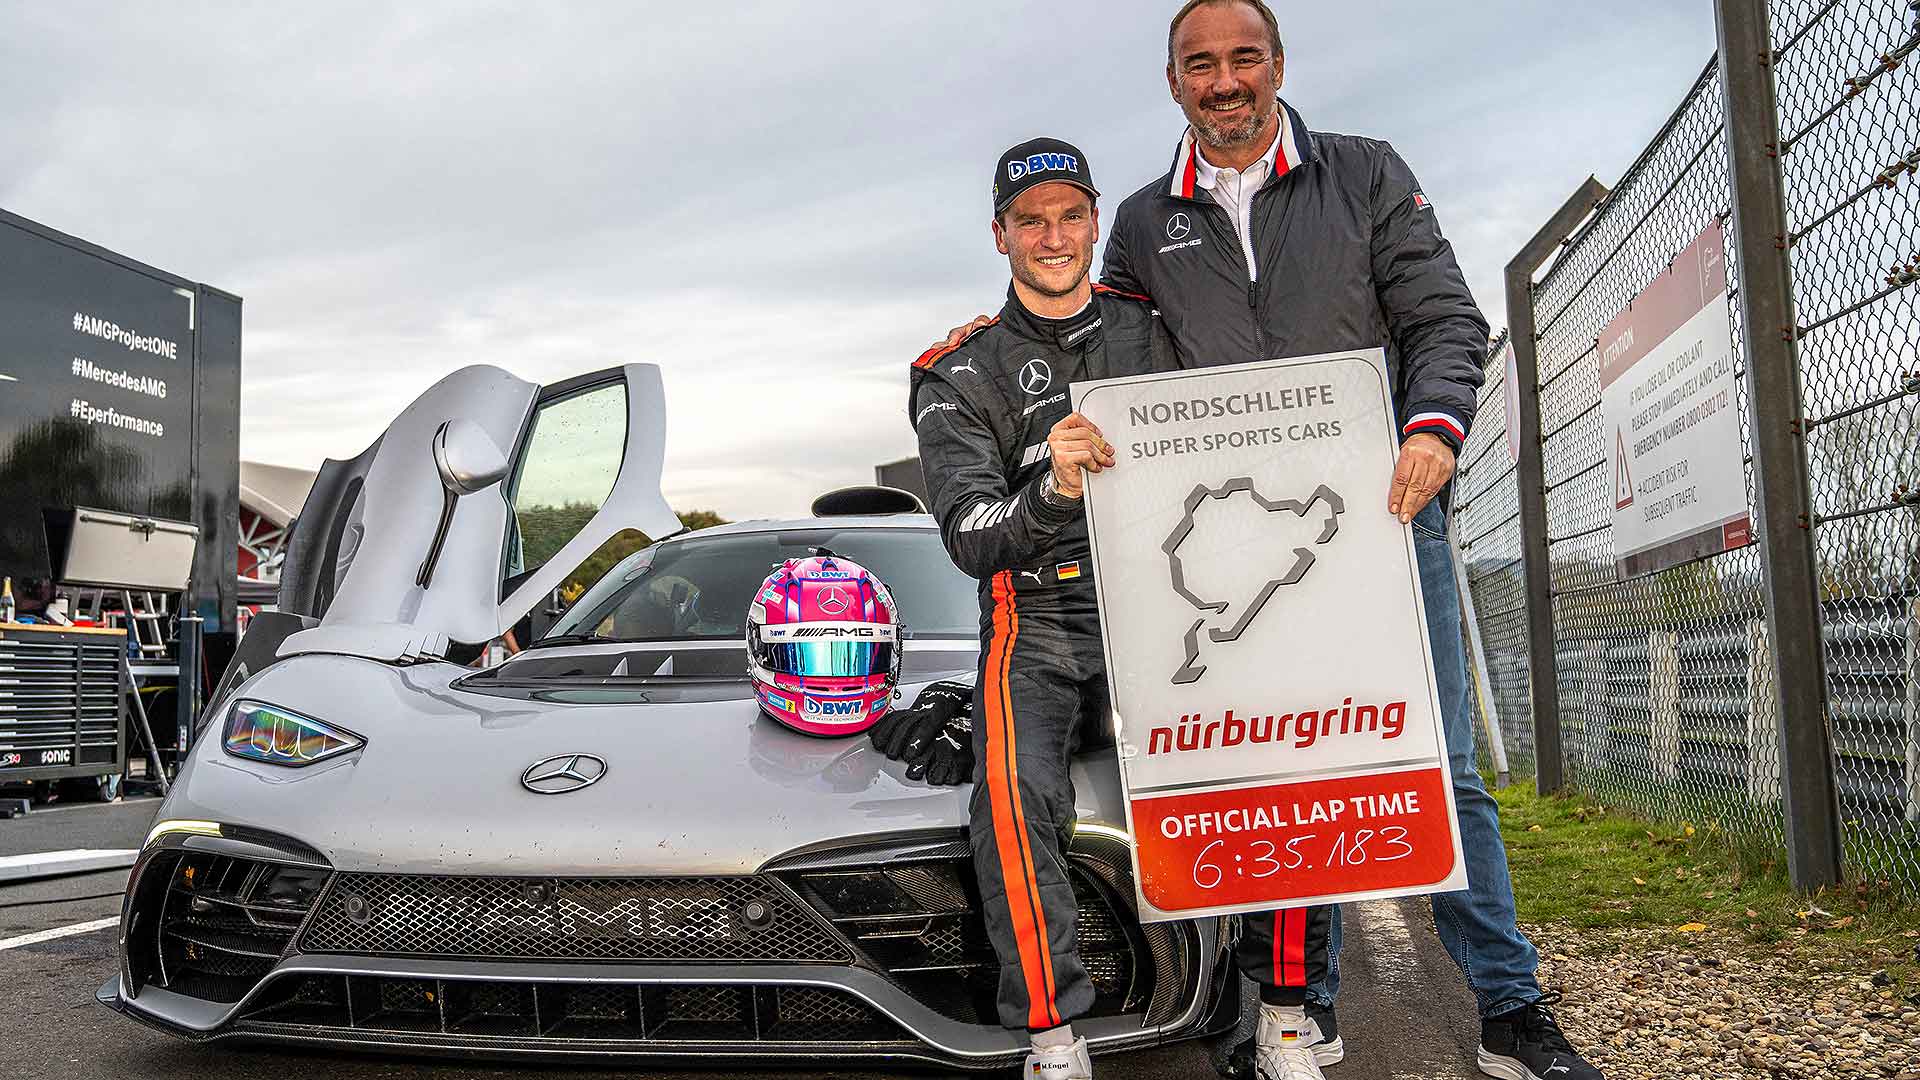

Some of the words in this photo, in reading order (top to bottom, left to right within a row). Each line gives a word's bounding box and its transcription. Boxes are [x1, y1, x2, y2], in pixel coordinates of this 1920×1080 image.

[1027, 153, 1078, 174] BWT
[73, 311, 177, 360] #AMGProjectONE
[1603, 326, 1634, 369] ATTENTION
[72, 357, 167, 398] #MercedesAMG
[1646, 374, 1657, 396] LOSE
[1657, 368, 1667, 386] OIL
[1667, 361, 1676, 380] OR
[1676, 340, 1703, 374] COOLANT
[1129, 385, 1334, 426] NORDSCHLEIFE
[1632, 409, 1648, 432] PLEASE
[1648, 400, 1661, 422] STOP
[1661, 375, 1698, 413] IMMEDIATELY
[1699, 366, 1713, 389] AND
[1713, 354, 1730, 379] CALL
[71, 398, 163, 437] #Eperformance
[1633, 429, 1663, 459] EMERGENCY
[1662, 415, 1686, 441] NUMBER
[1131, 436, 1198, 459] SUPER
[1203, 427, 1282, 451] SPORTS
[1287, 420, 1342, 441] CARS
[1643, 471, 1665, 494] ACCIDENT
[1665, 467, 1677, 483] RISK
[1677, 460, 1688, 478] FOR
[1645, 495, 1674, 522] SUBSEQUENT
[1674, 485, 1697, 509] TRAFFIC
[815, 628, 874, 637] AMG
[822, 700, 863, 715] BWT
[1148, 697, 1406, 755] nürburgring
[1160, 804, 1288, 839] OFFICIAL
[1293, 799, 1345, 825] LAP
[1350, 791, 1420, 818] TIME
[1193, 826, 1413, 888] 6:35.183
